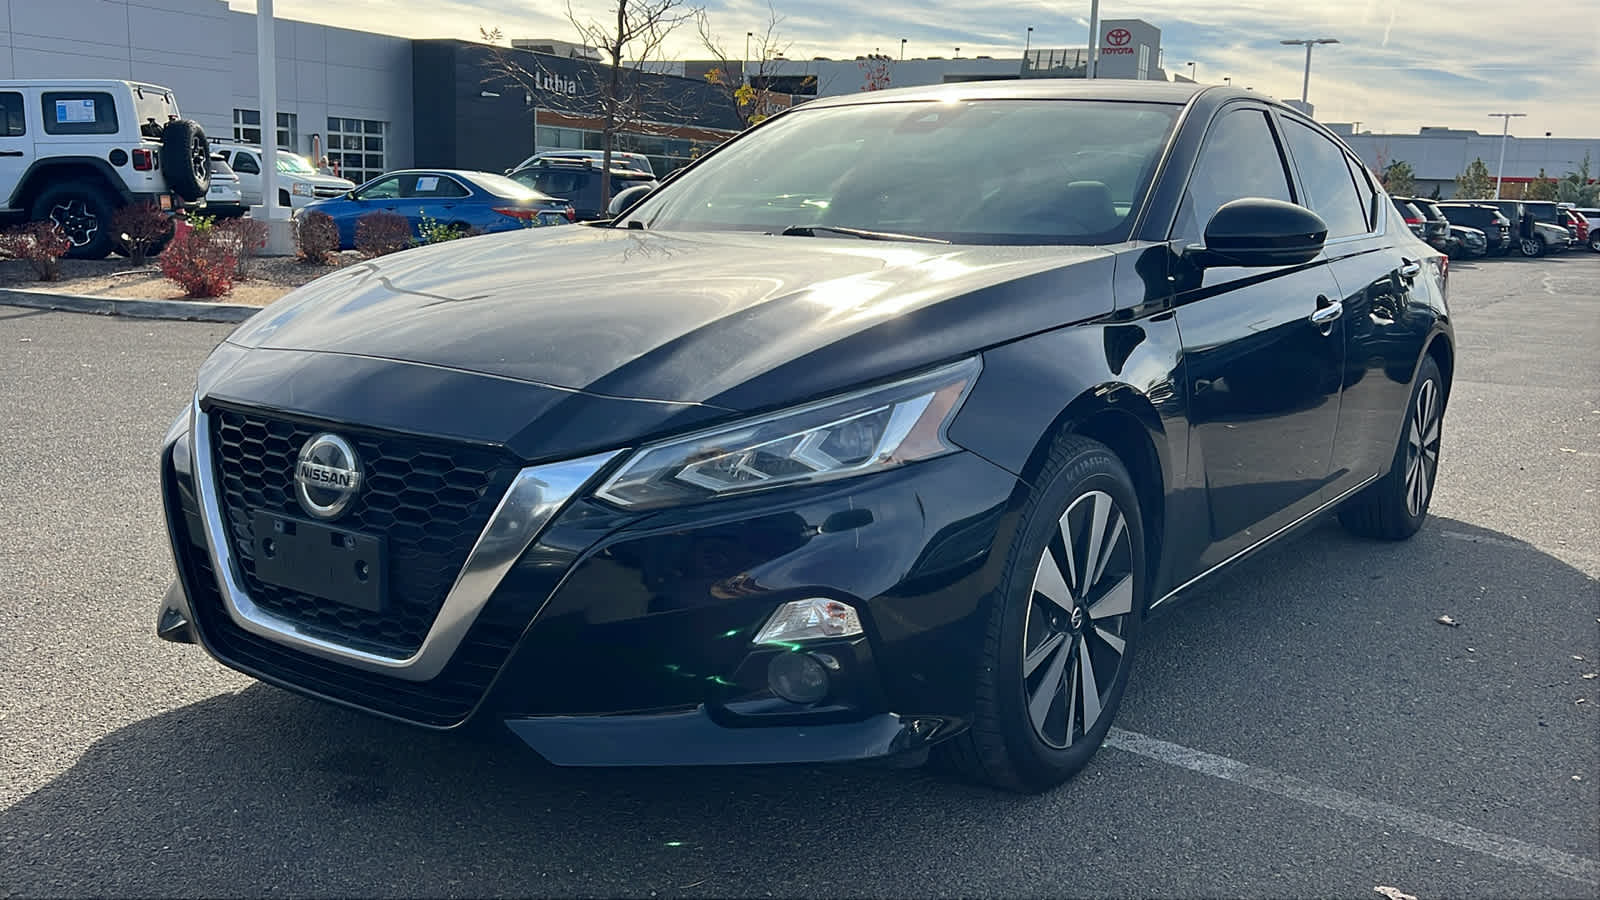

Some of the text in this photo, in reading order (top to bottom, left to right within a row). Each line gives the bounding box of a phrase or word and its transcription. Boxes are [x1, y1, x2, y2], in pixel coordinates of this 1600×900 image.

[1101, 47, 1134, 55] TOYOTA
[535, 71, 576, 94] Lithia
[300, 463, 351, 487] NISSAN
